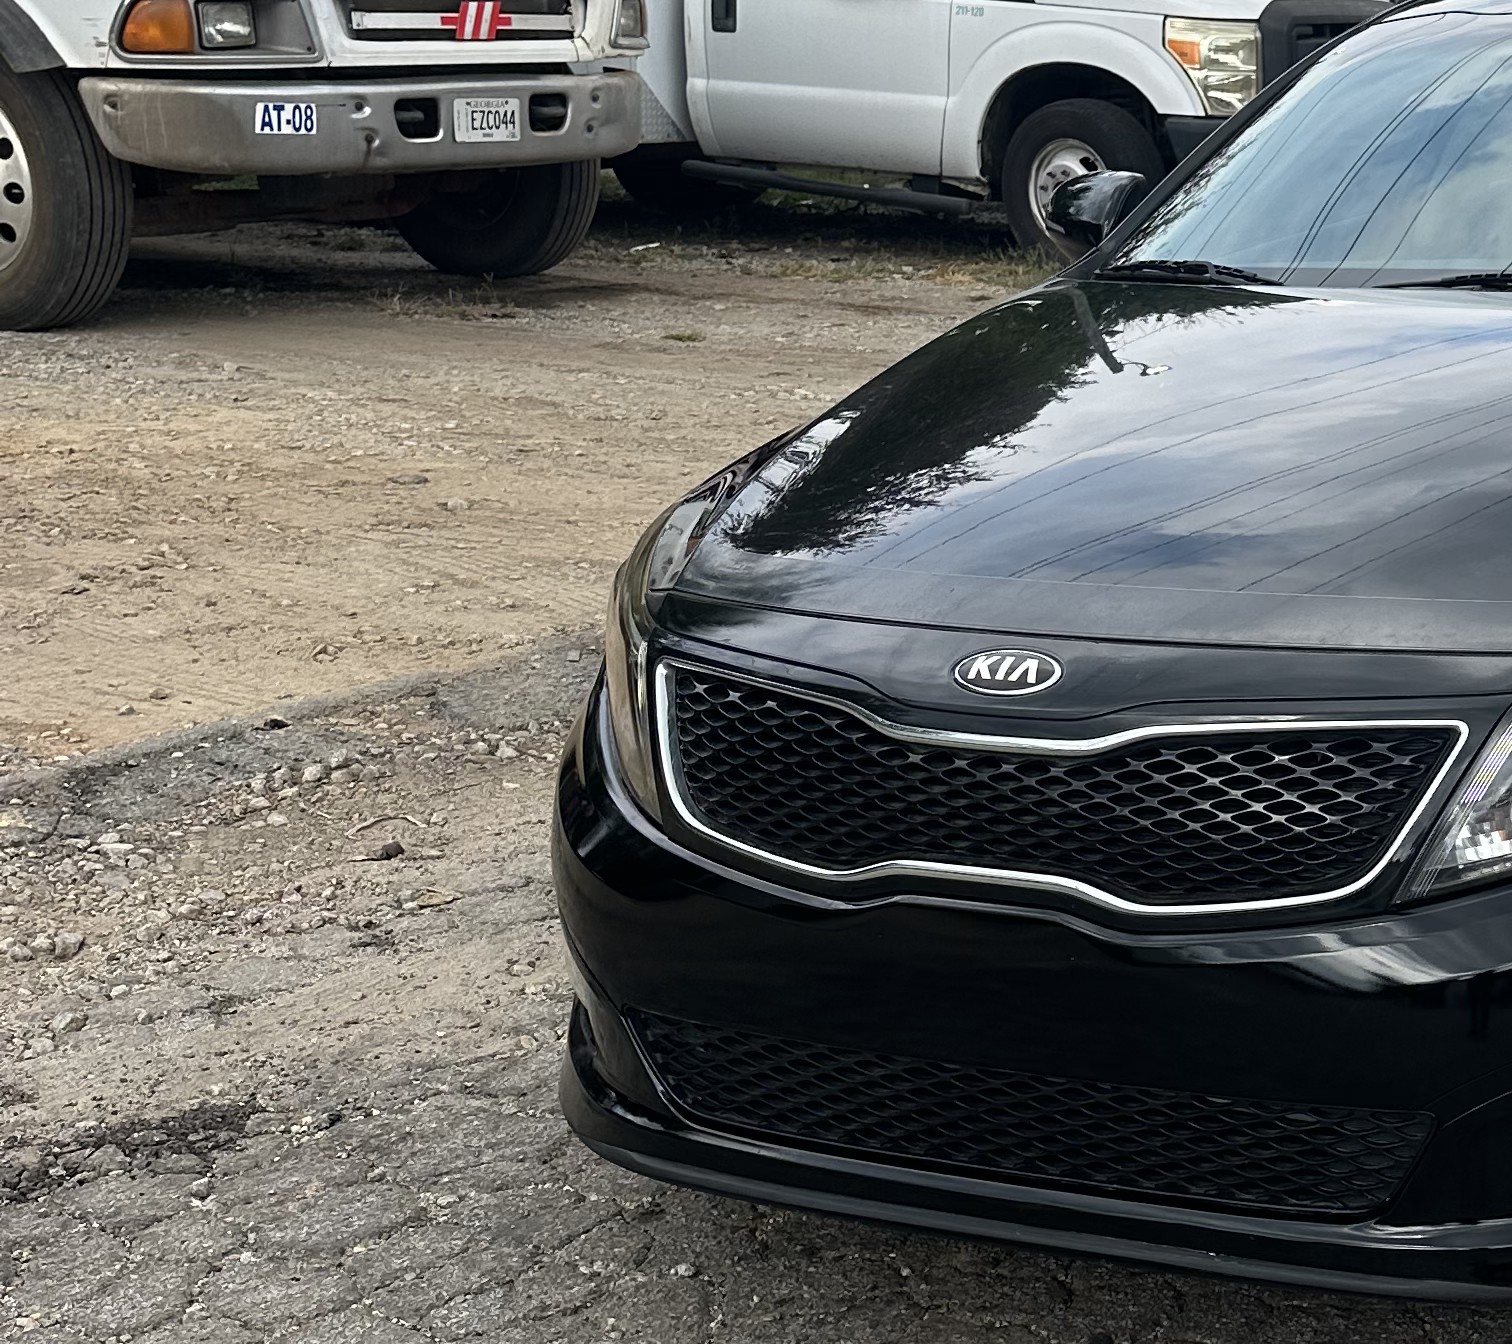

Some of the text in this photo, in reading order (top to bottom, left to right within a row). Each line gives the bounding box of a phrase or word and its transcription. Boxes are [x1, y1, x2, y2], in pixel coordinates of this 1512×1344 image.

[260, 104, 314, 133] AT-08
[471, 109, 516, 131] EZC044
[967, 655, 1040, 684] KIA
